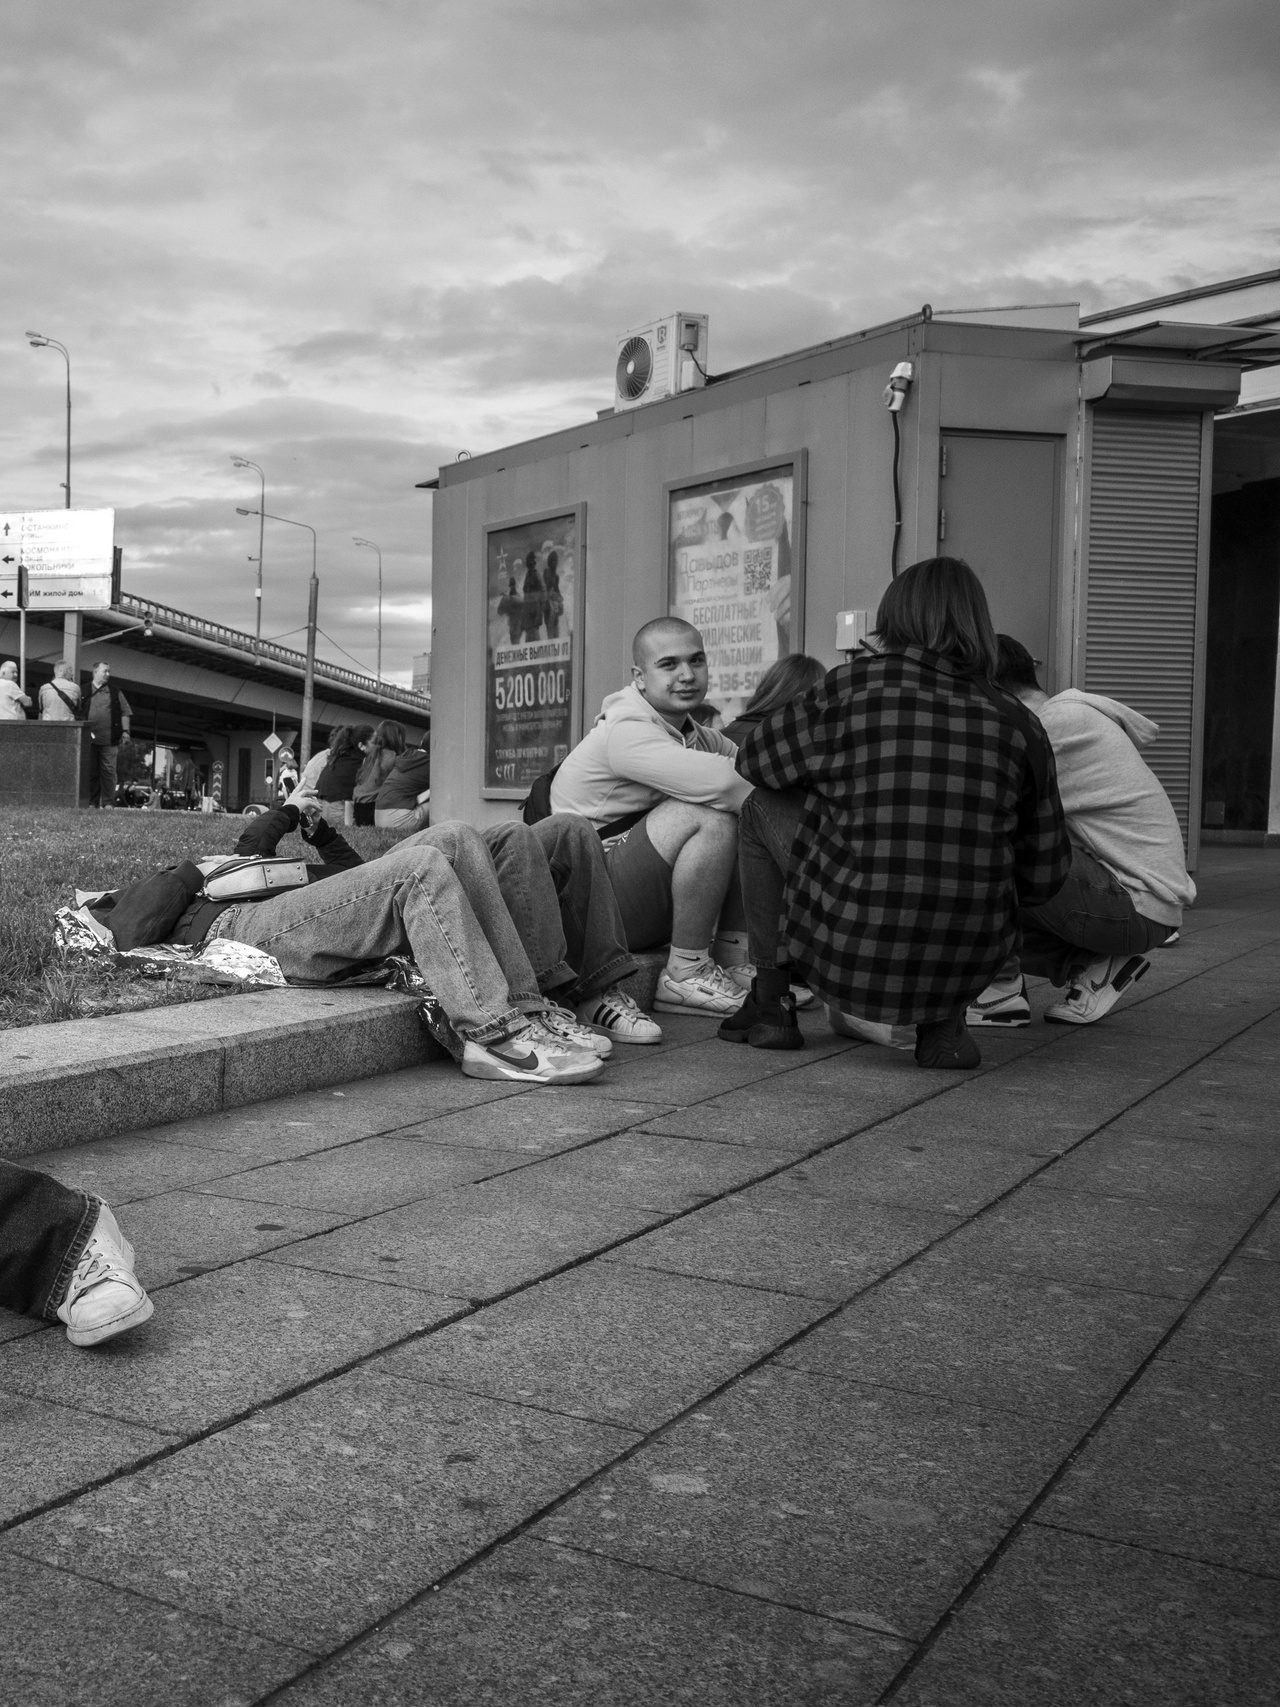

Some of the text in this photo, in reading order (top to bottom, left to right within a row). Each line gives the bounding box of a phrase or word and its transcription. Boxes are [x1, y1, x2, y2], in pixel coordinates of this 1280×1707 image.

[756, 494, 770, 514] 15
[25, 563, 75, 572] ОКОЛЬНИКИ
[42, 589, 67, 597] жилой
[67, 590, 84, 598] дом
[693, 600, 758, 625] БЕСПЛАТНЫЕ
[699, 622, 762, 648] РИДИЧЕСКИЕ
[496, 647, 529, 666] ДЕНЕЖНЫЕ
[529, 643, 560, 660] ВЫПЛАТЫ
[707, 645, 762, 668] СУЛЬТАЦИИ
[495, 672, 535, 710] 5200
